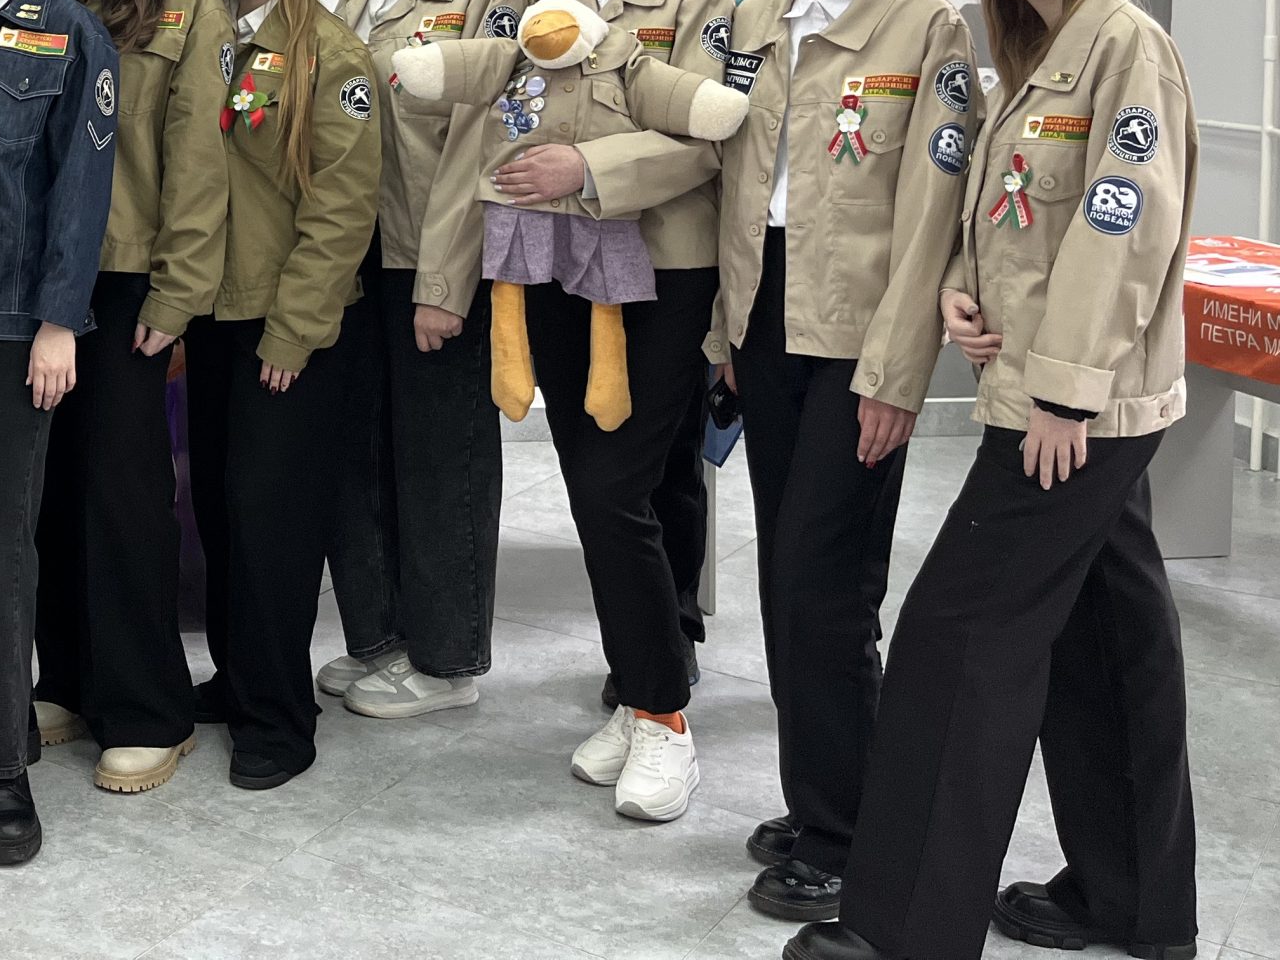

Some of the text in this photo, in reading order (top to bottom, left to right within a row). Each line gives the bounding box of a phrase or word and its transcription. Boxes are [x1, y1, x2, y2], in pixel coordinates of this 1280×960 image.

[935, 152, 961, 168] ПОБЕД
[1090, 211, 1133, 227] ПОБЕДЫ
[1202, 298, 1261, 328] ИМЕНИ
[1200, 322, 1261, 351] ПЕТРА
